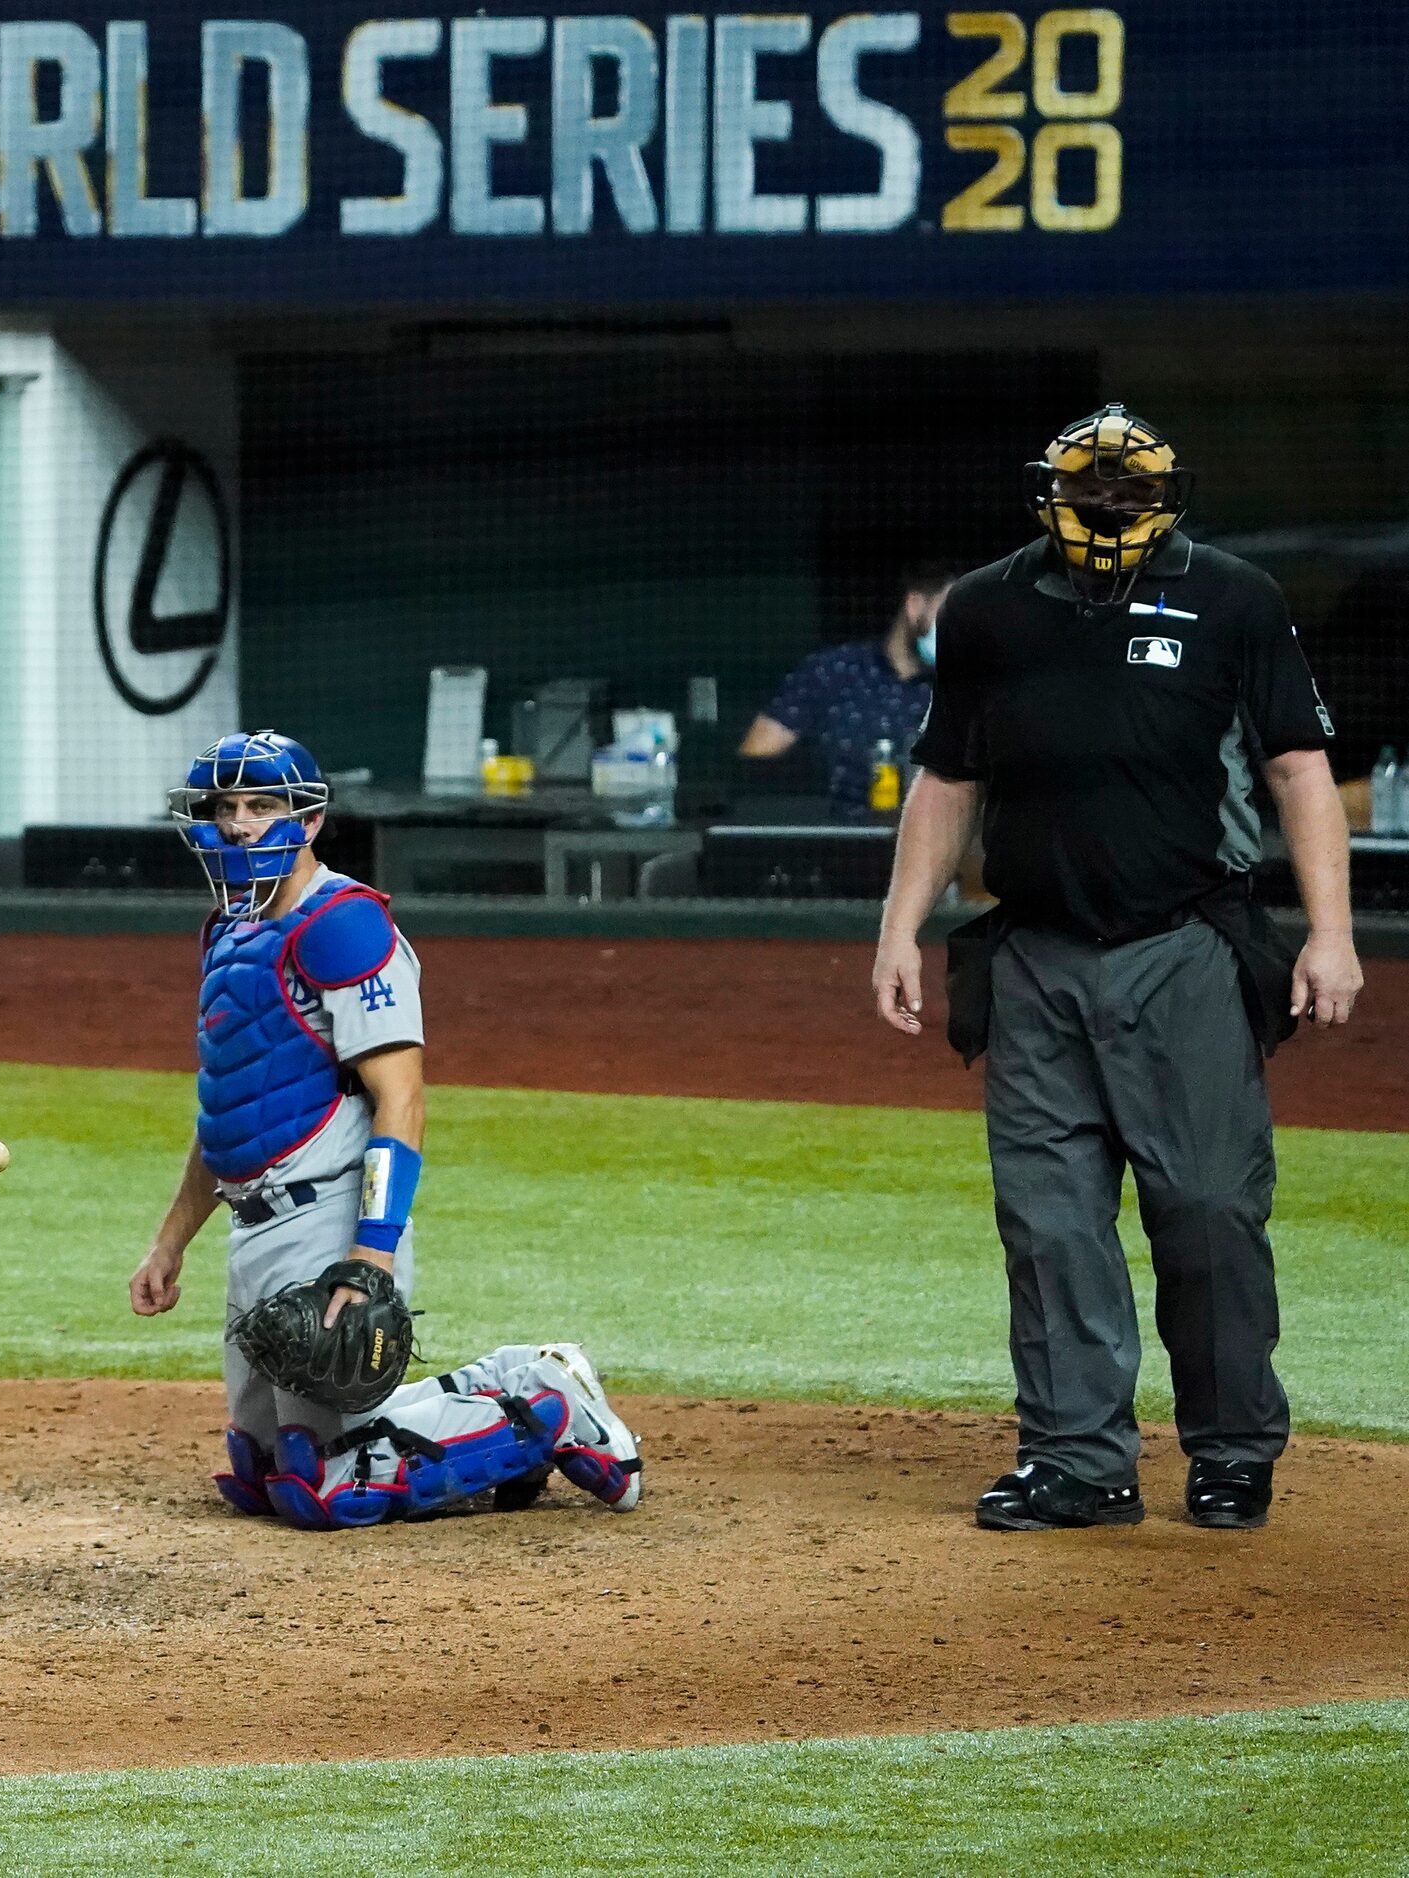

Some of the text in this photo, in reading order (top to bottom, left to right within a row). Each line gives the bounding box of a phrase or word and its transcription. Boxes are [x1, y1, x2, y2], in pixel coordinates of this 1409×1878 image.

[943, 8, 1125, 119] 20
[340, 13, 921, 236] SERIES
[941, 121, 1123, 232] 20
[360, 973, 396, 1012] LA
[370, 1327, 384, 1370] A2000
